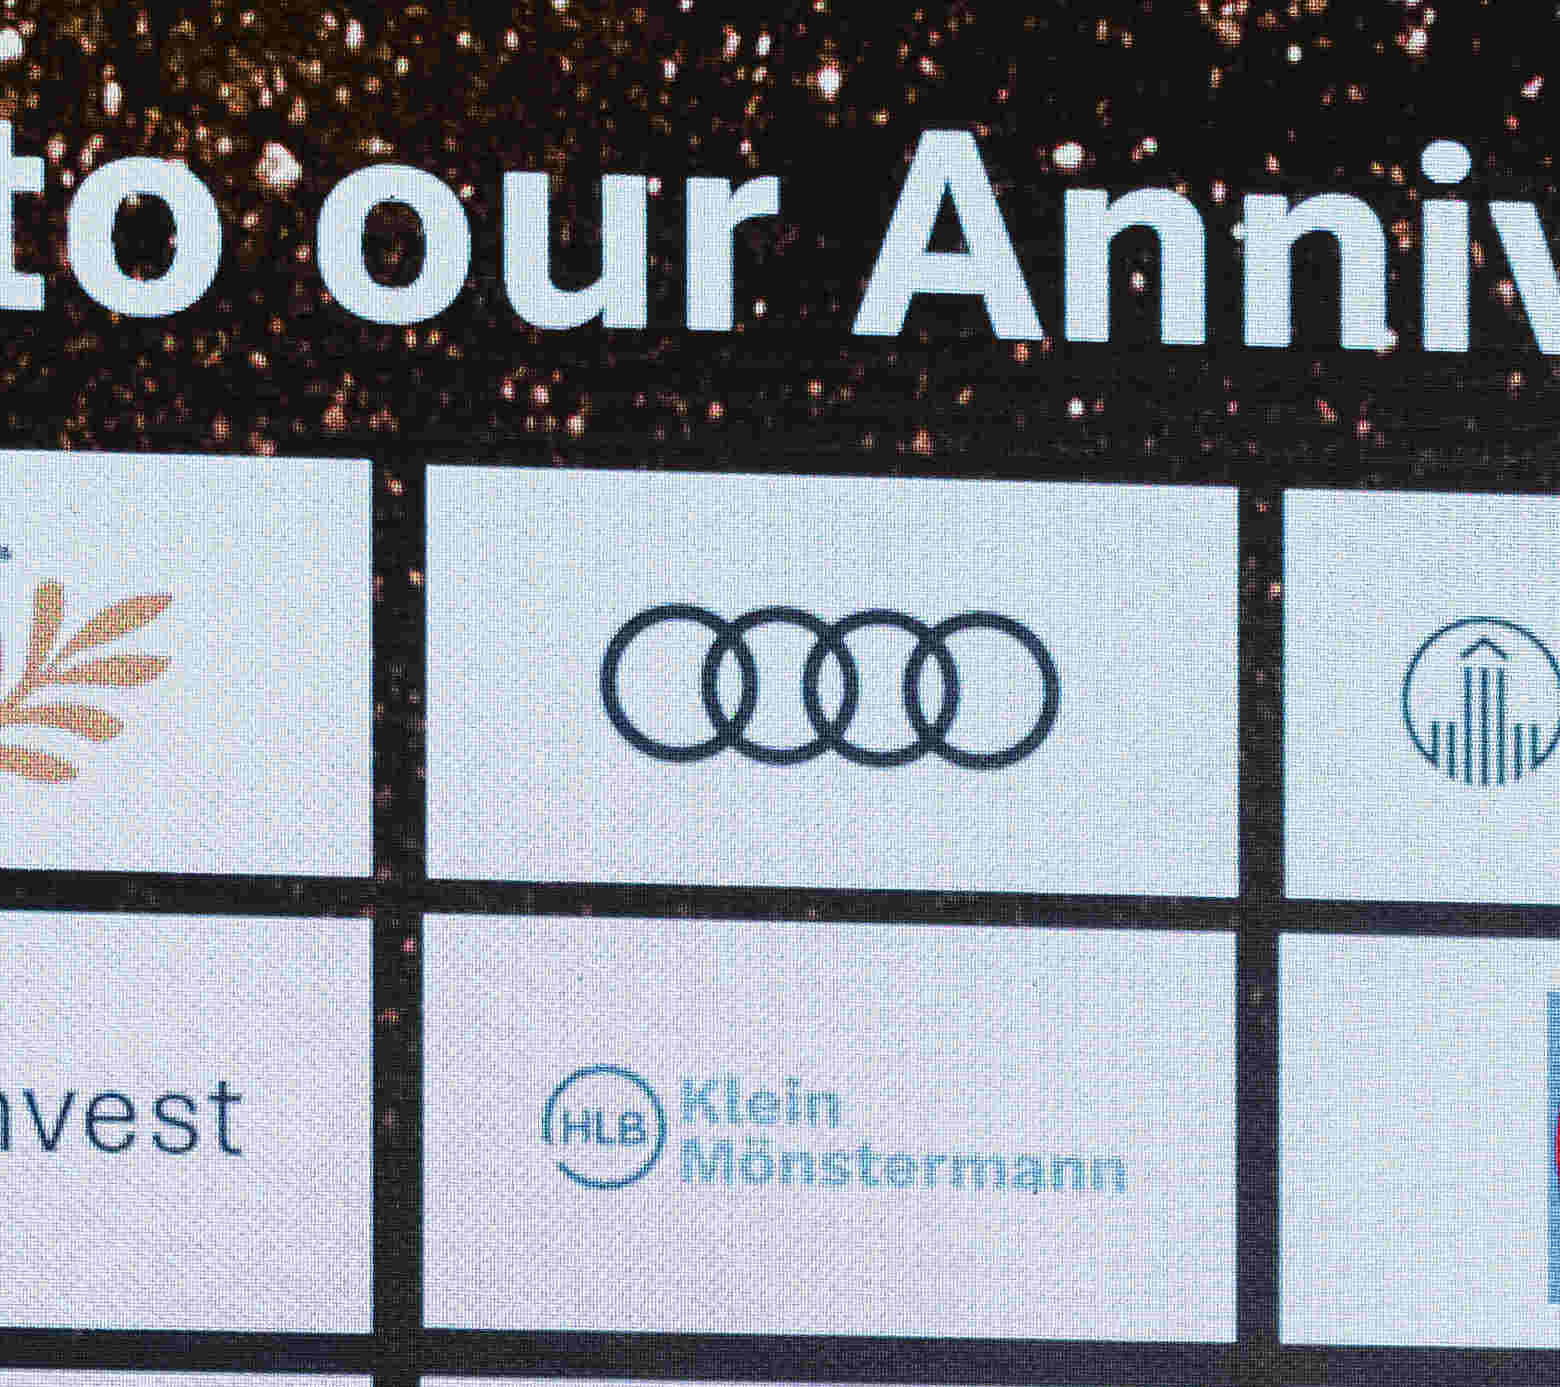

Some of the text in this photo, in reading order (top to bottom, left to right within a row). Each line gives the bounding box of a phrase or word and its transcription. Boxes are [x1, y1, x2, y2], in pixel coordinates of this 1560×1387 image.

[318, 165, 778, 330] our
[562, 1109, 648, 1147] HLB
[682, 1077, 840, 1128] Klein
[681, 1137, 1126, 1194] Mönstermann
